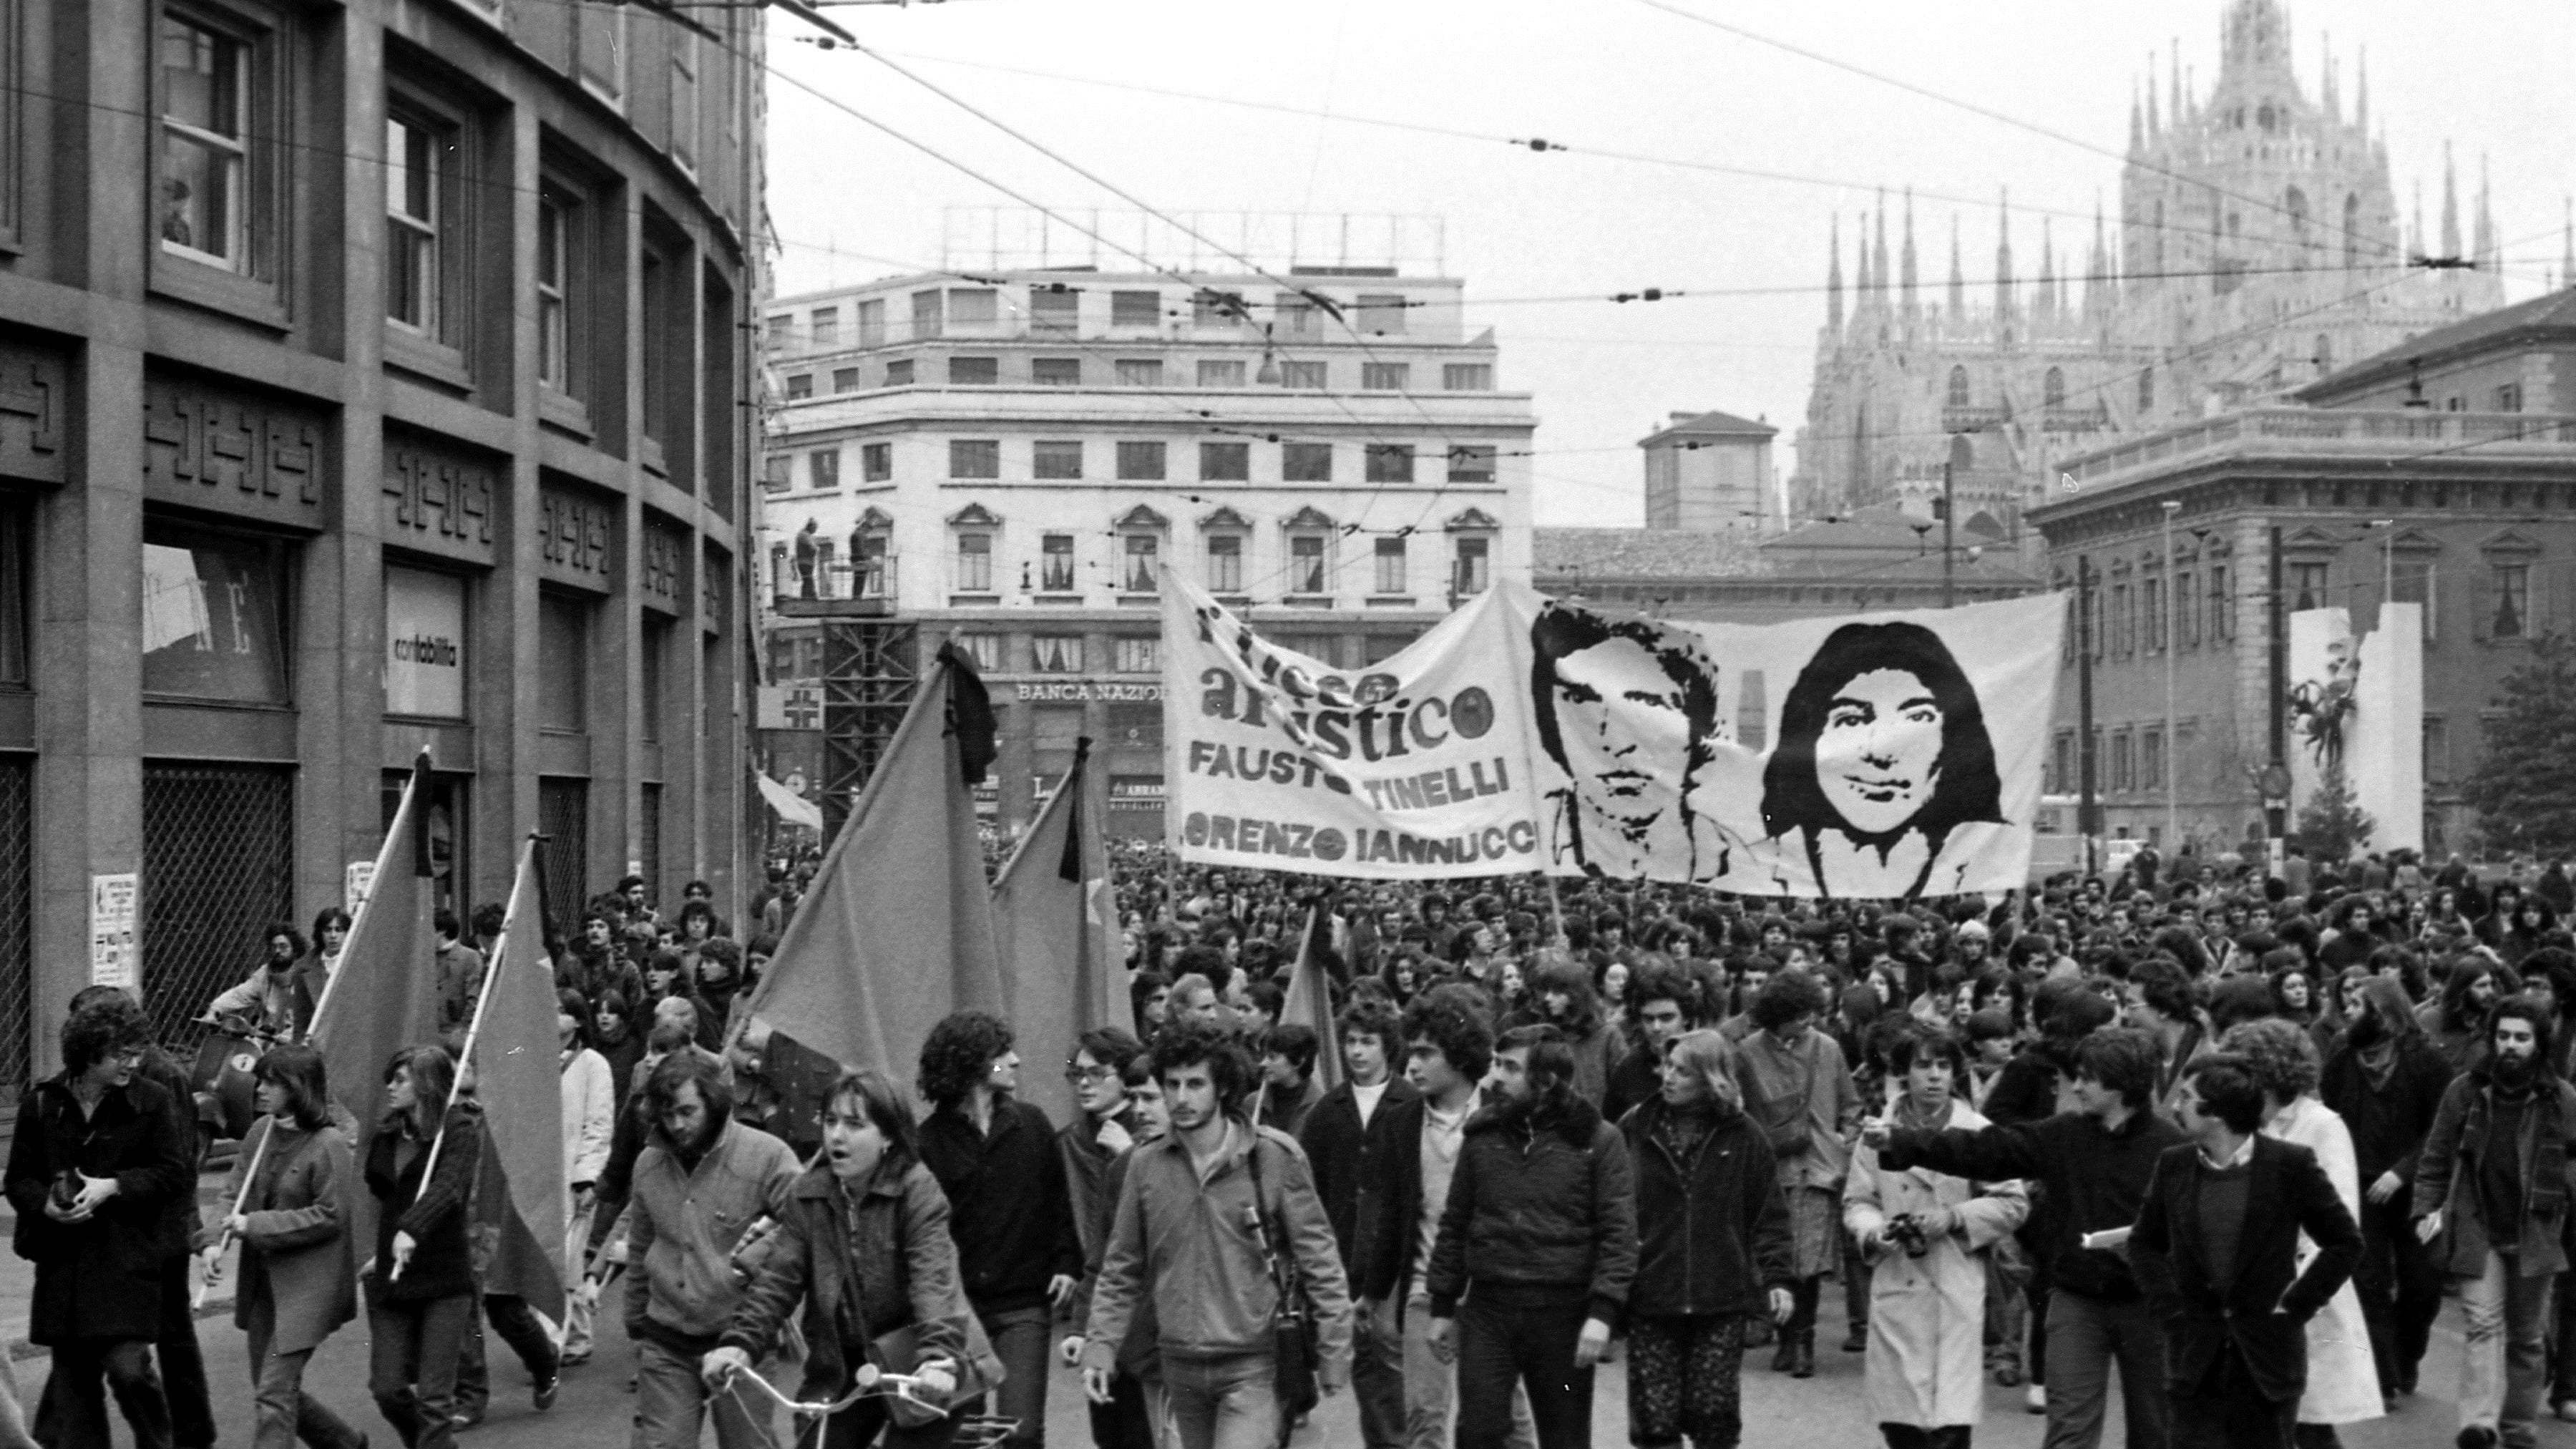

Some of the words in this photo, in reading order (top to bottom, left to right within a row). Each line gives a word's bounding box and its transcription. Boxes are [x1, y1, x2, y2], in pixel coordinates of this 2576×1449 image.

[1018, 684, 1090, 701] BANCA
[1096, 684, 1163, 701] NAZIO
[1200, 666, 1495, 763] aristico
[1362, 757, 1511, 811] TINELLI
[1179, 811, 1347, 862] ORENZO
[1356, 819, 1540, 864] IANNUCC
